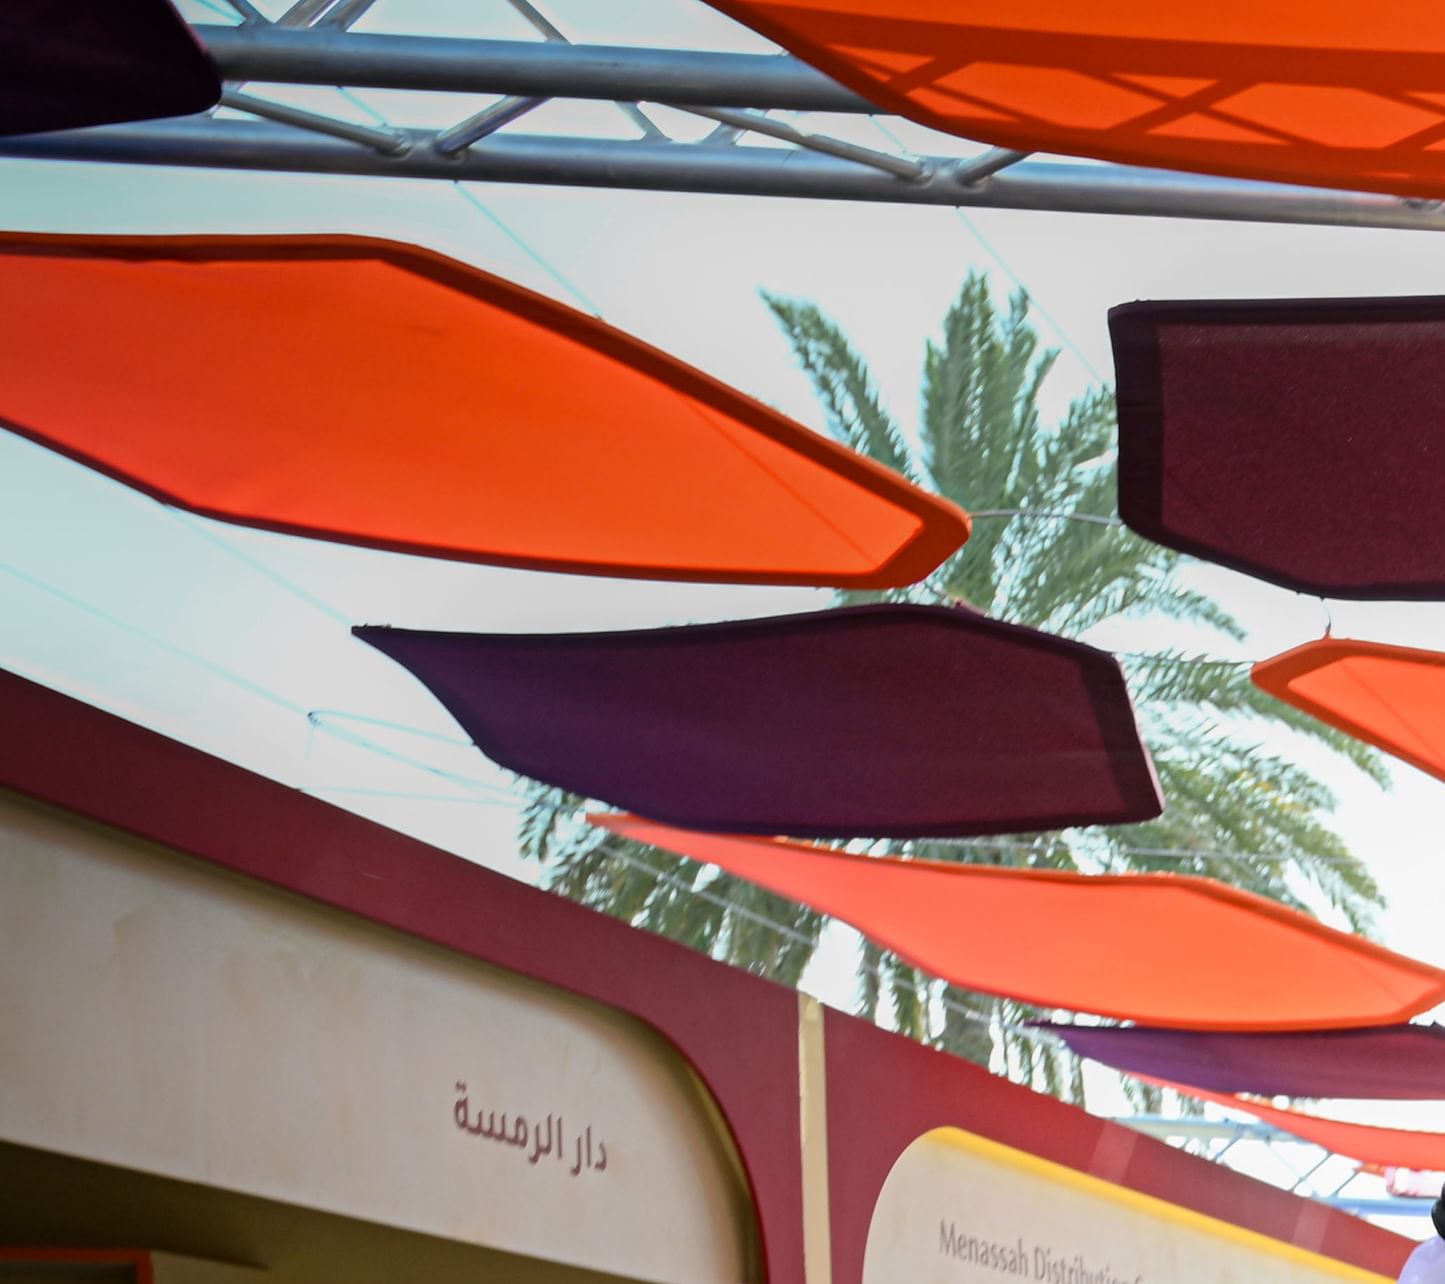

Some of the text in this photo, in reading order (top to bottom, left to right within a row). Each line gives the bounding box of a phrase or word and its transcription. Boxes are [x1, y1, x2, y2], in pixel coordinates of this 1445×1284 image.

[453, 1079, 608, 1177] دار الرمسة
[938, 1218, 1030, 1278] Menassah
